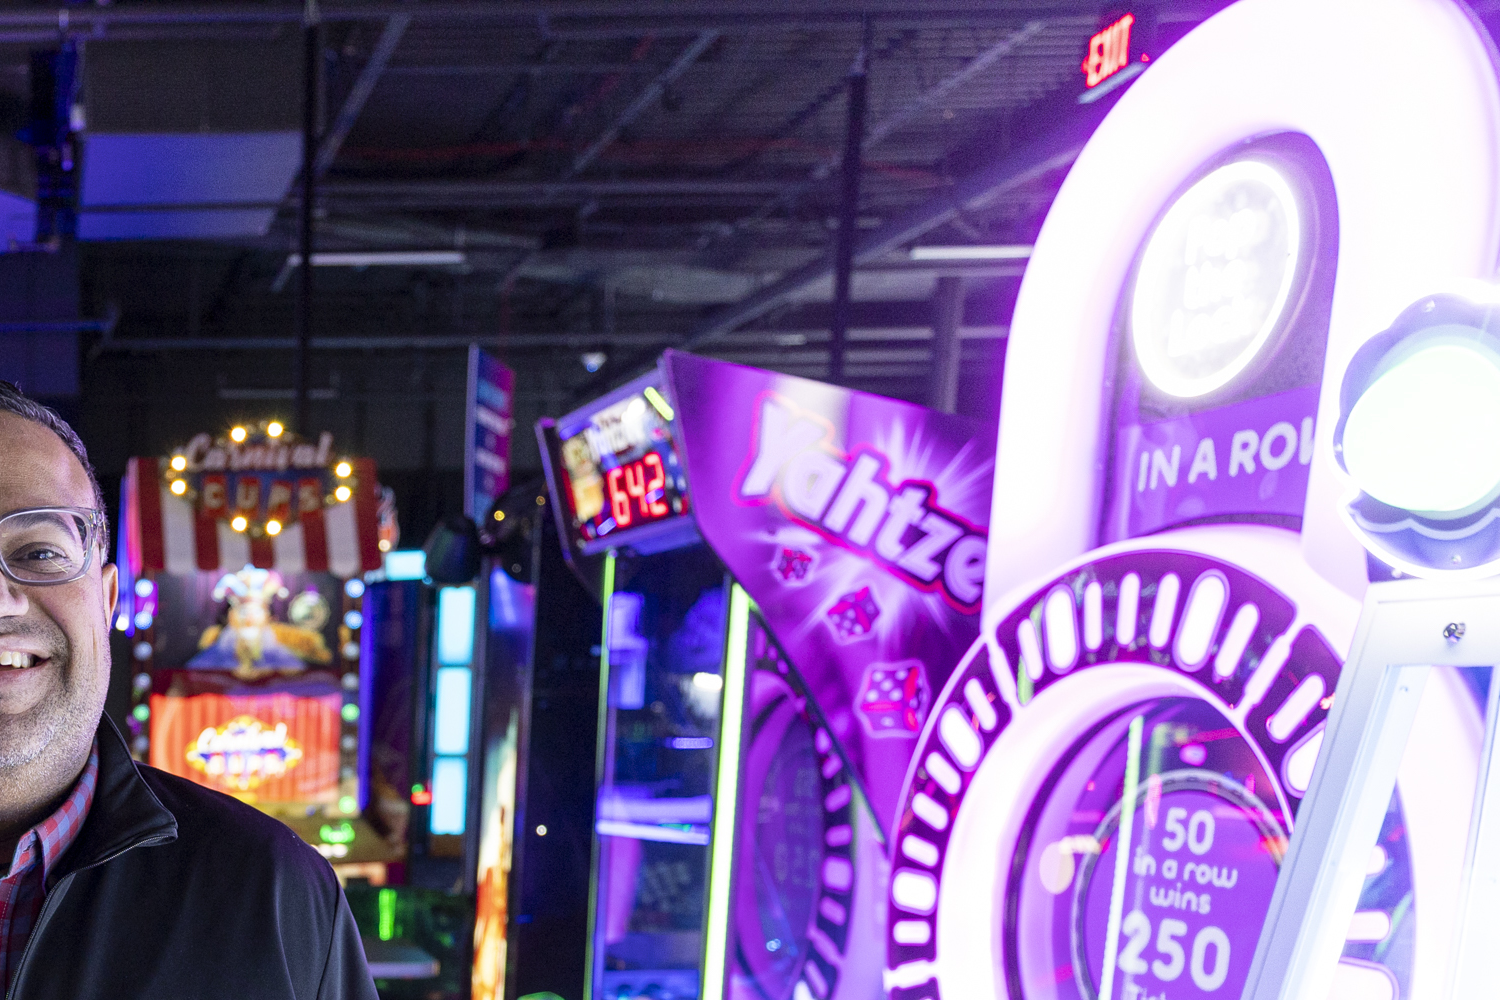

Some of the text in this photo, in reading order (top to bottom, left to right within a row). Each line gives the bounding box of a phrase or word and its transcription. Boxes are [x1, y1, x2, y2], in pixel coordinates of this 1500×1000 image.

[186, 431, 334, 472] Carnival
[1137, 444, 1182, 494] IN
[1187, 437, 1218, 485] A
[202, 479, 322, 513] CUPS
[606, 450, 670, 529] 642
[1161, 806, 1216, 856] 50
[1132, 844, 1239, 889] in a row
[1149, 881, 1211, 915] wins
[1117, 909, 1232, 992] 250
